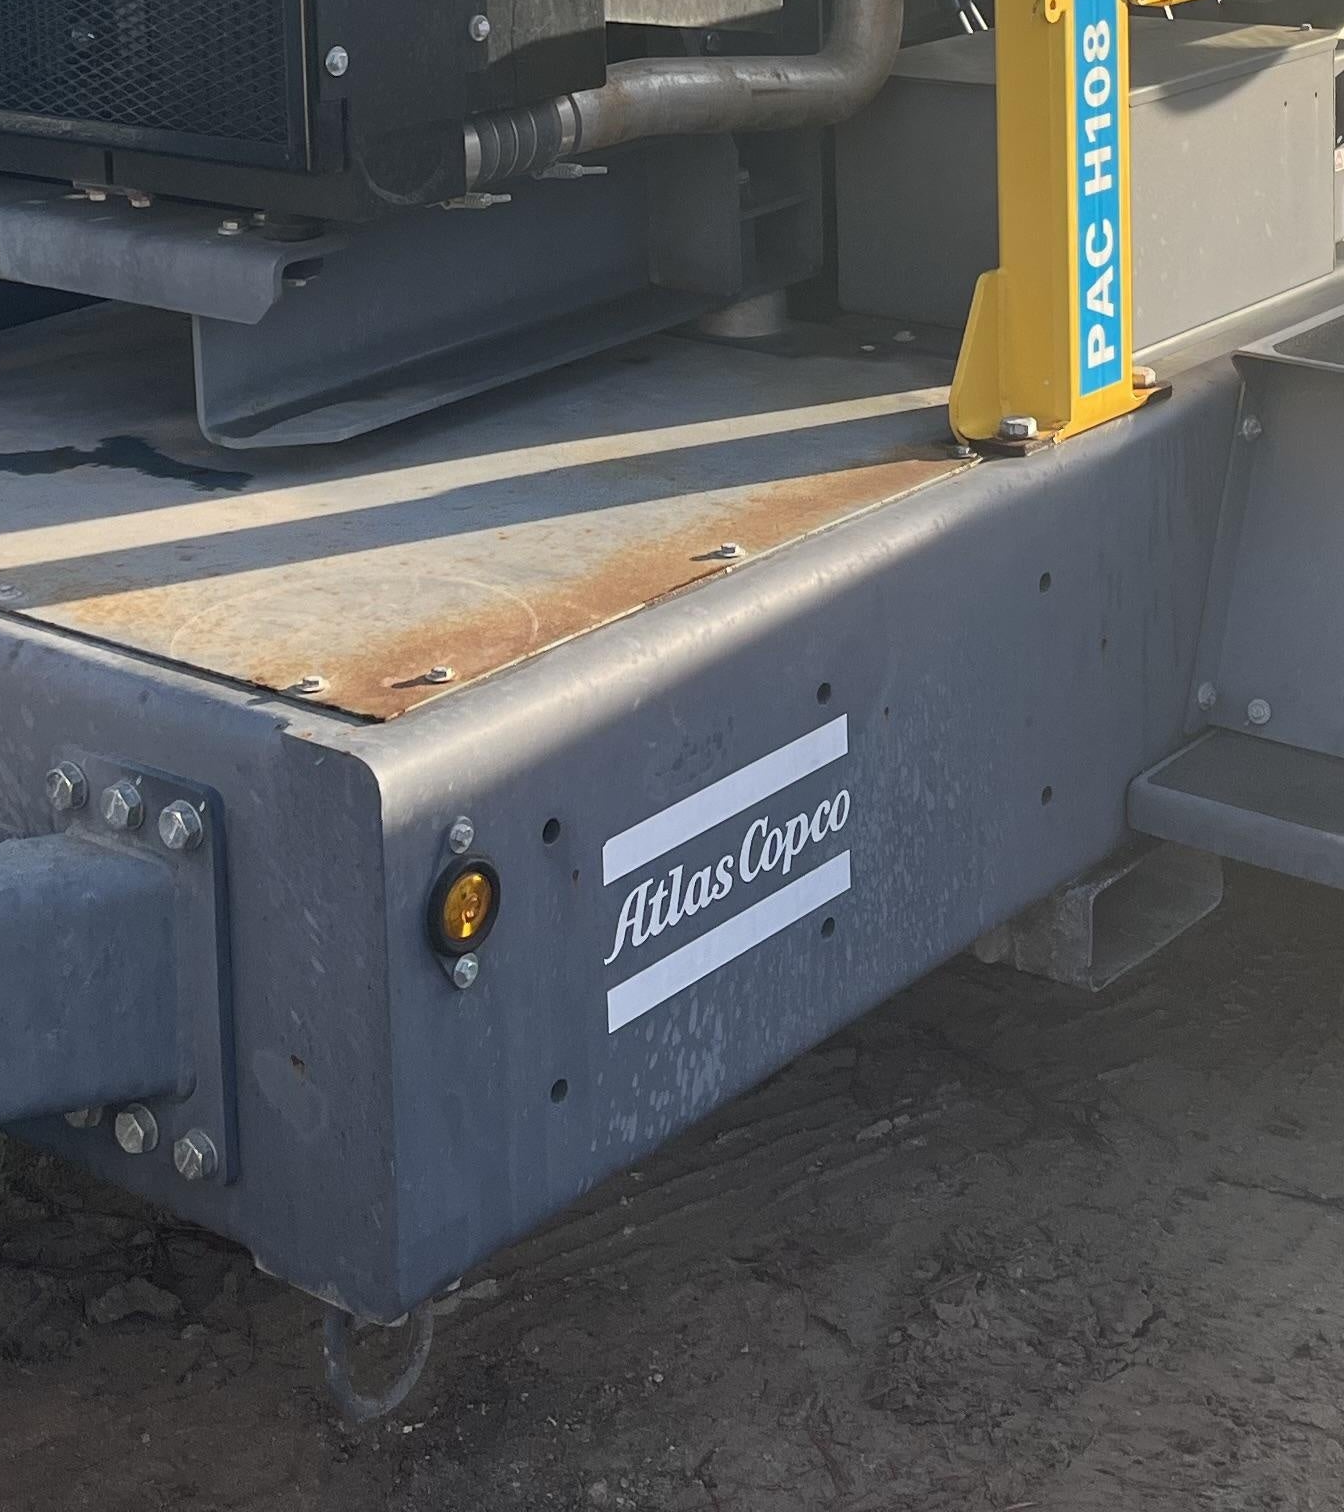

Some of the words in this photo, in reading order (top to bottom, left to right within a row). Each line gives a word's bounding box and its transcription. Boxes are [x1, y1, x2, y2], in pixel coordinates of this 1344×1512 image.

[1083, 19, 1112, 196] H108
[1086, 218, 1116, 369] PAC
[604, 854, 734, 965] Atlas
[739, 789, 851, 883] Copco
